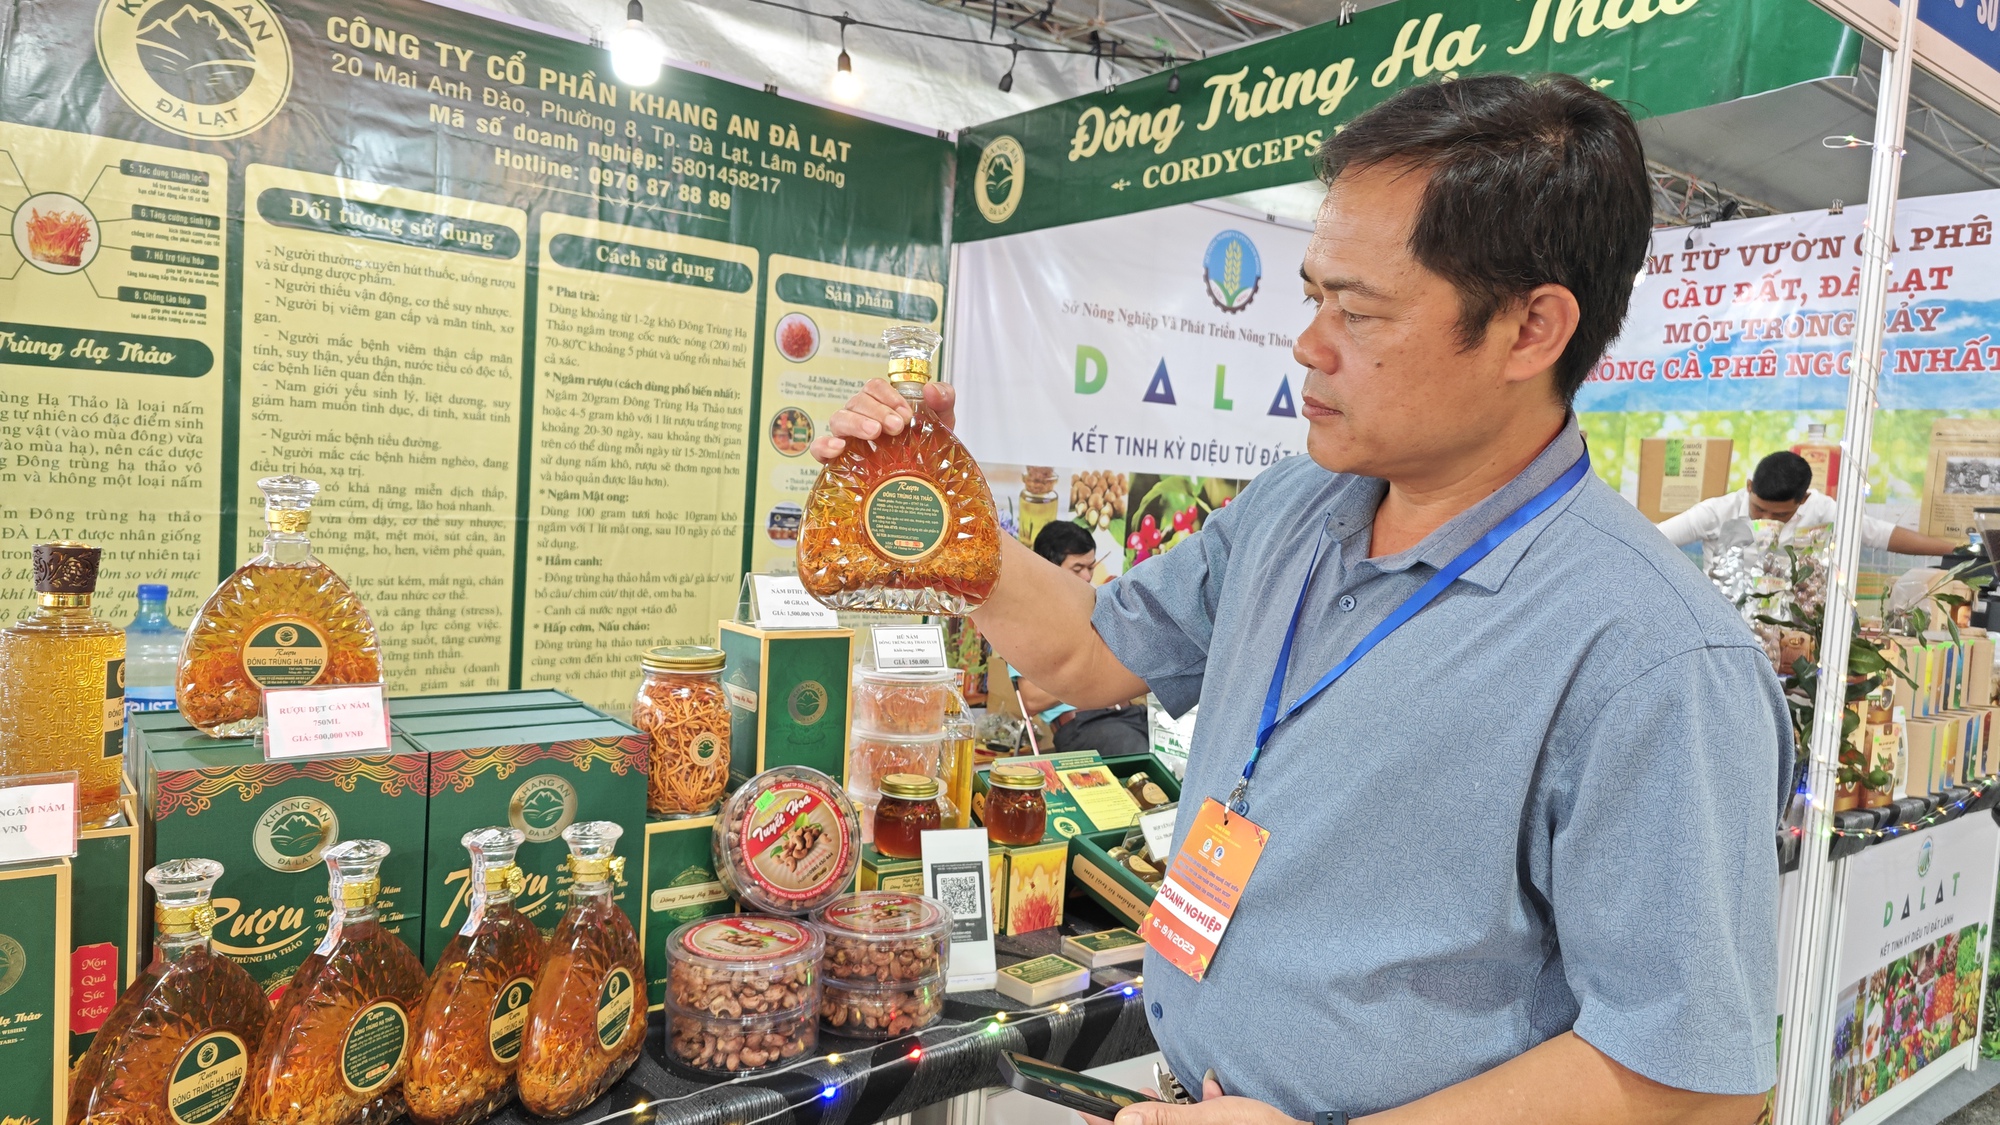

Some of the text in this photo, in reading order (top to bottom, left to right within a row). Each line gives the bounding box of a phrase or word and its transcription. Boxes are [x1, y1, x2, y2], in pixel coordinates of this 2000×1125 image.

[232, 4, 274, 42] AN
[326, 16, 852, 163] CÔNG TY CỔ PHẦN KHANG AN ĐÀ LẠT
[155, 97, 239, 128] ĐÀ LẠT
[331, 53, 845, 189] 20 Mai Anh Đào, Phường 8, Tp. Đà Lạt, Lâm Đồng
[1068, 103, 1185, 162] Đông
[1196, 57, 1358, 131] Trùng
[429, 103, 781, 194] Mã số doanh nghiệp: 5801458217
[1143, 128, 1323, 190] CORDYCEPS
[494, 146, 731, 210] Hotline: 0976 87 88 89
[290, 197, 495, 250] Đối tượng sử dụng
[1909, 213, 1993, 252] PHÊ
[274, 245, 316, 262] Người
[317, 249, 362, 270] thường
[364, 260, 401, 274] xuyên
[403, 263, 422, 275] hút
[596, 245, 716, 282] Cách sử dụng
[1681, 243, 1729, 272] TỪ
[1737, 233, 1847, 267] VƯỜN
[825, 285, 894, 310] Sản phẩm
[1662, 277, 1727, 310] CẦU
[1061, 299, 1293, 348] Sở Nông Nghiệp Và Phát Triển Nông Thôn
[1663, 315, 1734, 350] MỘT
[1740, 310, 1855, 342] TRONG
[0, 331, 176, 365] Trùng Hạ Thảo
[1662, 350, 1701, 380] CÀ
[1709, 347, 1778, 380] PHÊ
[13, 408, 204, 430] tự nhiên có đặc điểm sinh
[37, 392, 204, 415] Hạ Thảo là loại nấm
[1071, 425, 1108, 453] KẾT
[1114, 435, 1158, 457] TINH
[1163, 435, 1186, 459] KỲ
[1190, 439, 1230, 469] DIỆU
[1234, 441, 1256, 465] TỪ
[540, 505, 569, 519] Dùng
[577, 507, 595, 518] 100
[600, 510, 626, 521] gram
[656, 509, 679, 521] hoặc
[721, 511, 738, 521] khô
[279, 706, 306, 715] RƯỢU
[262, 801, 330, 828] KHANG AN
[277, 856, 291, 866] ĐÀ
[1160, 883, 1222, 933] DOANH NGHIỆP
[81, 958, 107, 971] Món
[81, 974, 106, 986] Quà
[82, 990, 105, 1003] Sức
